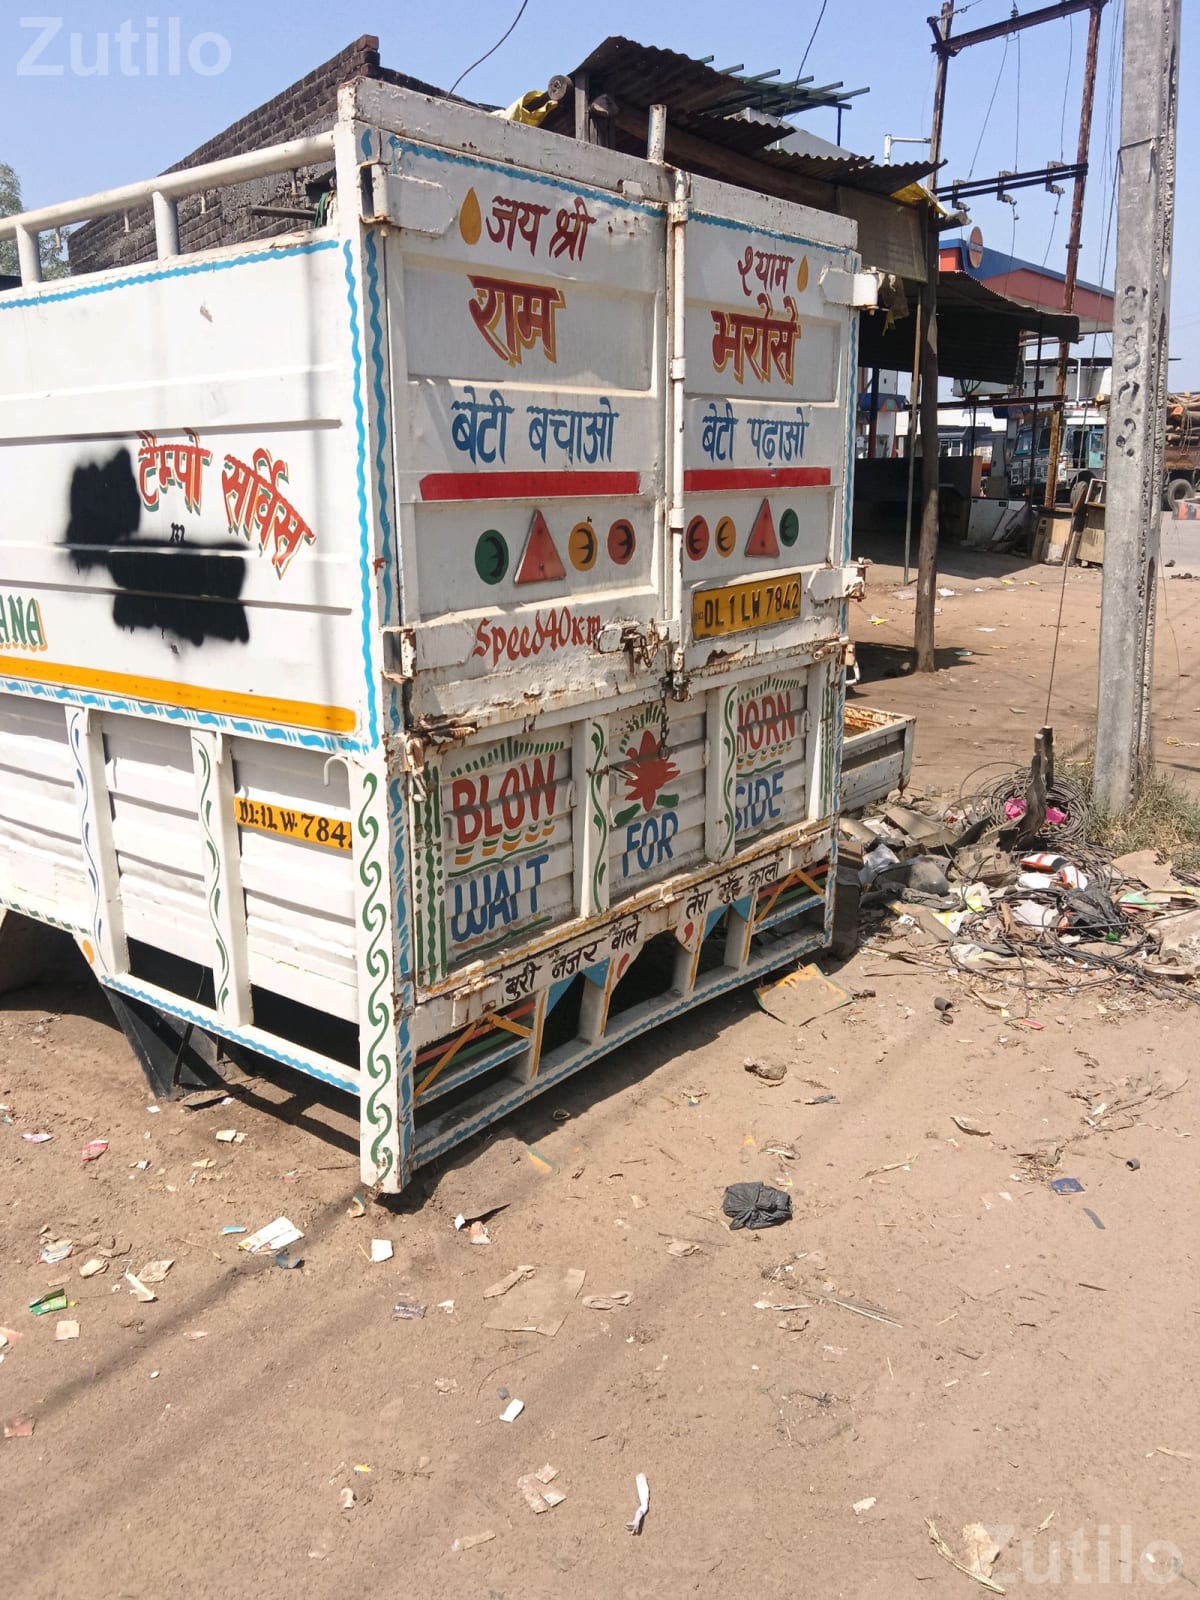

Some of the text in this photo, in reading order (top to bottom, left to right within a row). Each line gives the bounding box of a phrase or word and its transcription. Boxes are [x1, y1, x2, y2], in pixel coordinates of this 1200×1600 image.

[485, 195, 551, 257] जय
[548, 196, 597, 262] श्री
[467, 273, 801, 386] राम भरोसे
[451, 385, 515, 464] बेटी
[526, 396, 620, 464] बचाओ
[702, 402, 738, 462] बेटी
[452, 691, 795, 845] BLOW HORN
[451, 771, 784, 942] WAIT FOR SIDE
[505, 962, 542, 1001] बुरी
[606, 914, 642, 950] वाले
